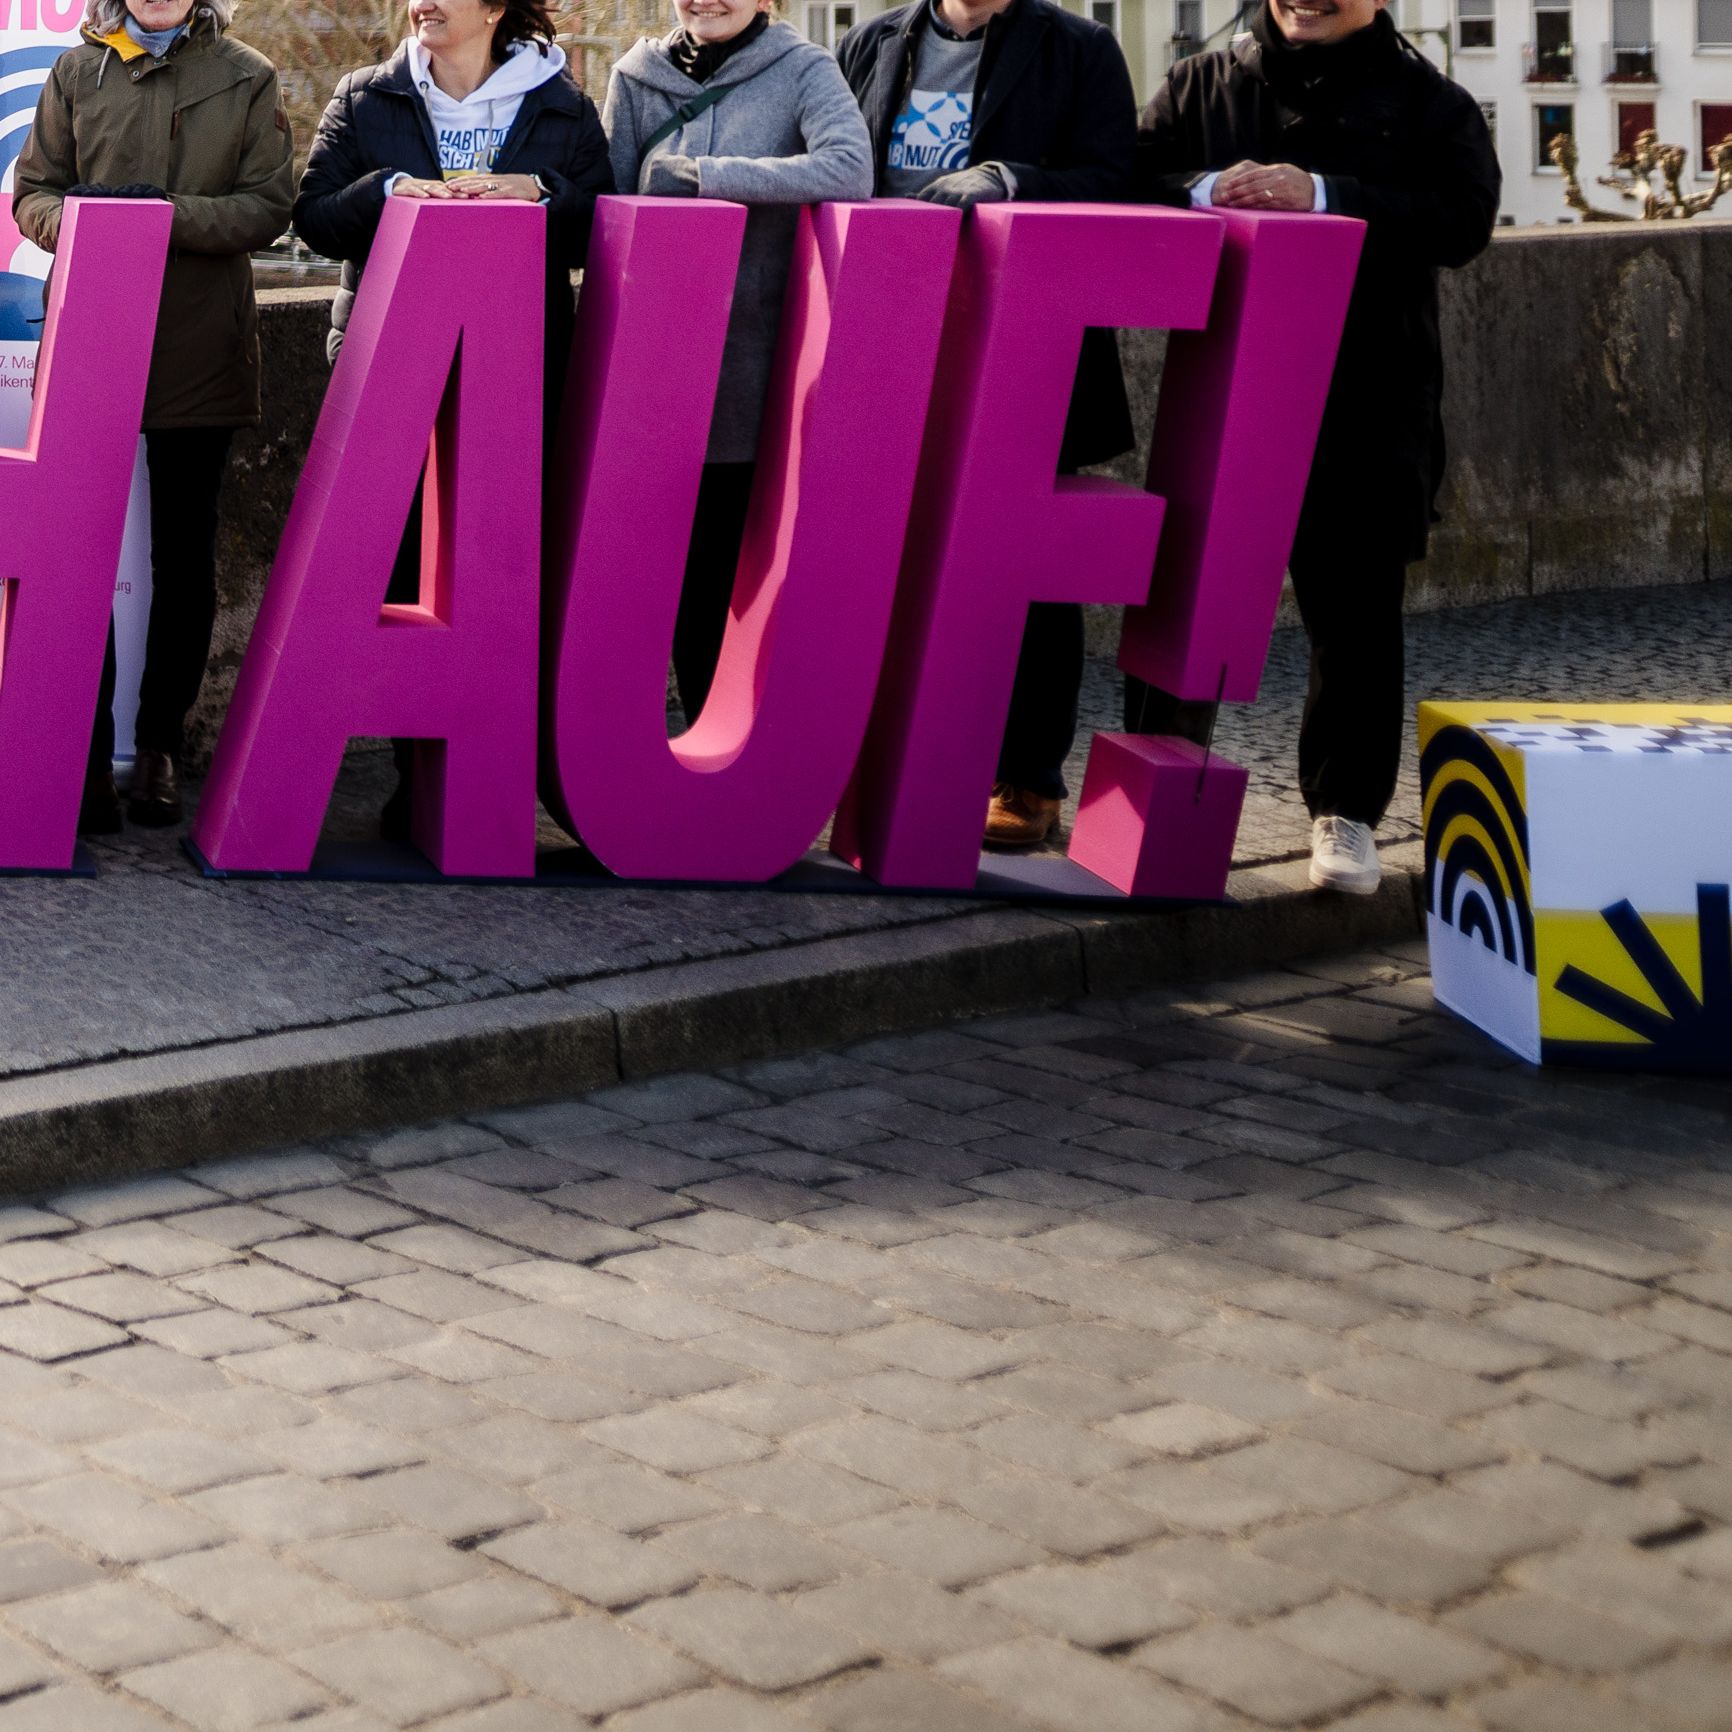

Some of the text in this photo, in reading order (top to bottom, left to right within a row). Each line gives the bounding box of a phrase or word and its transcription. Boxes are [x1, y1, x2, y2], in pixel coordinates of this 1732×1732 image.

[440, 130, 472, 150] HAB
[439, 146, 472, 169] STEH
[12, 356, 35, 369] Ma
[189, 194, 1369, 899] AUF!
